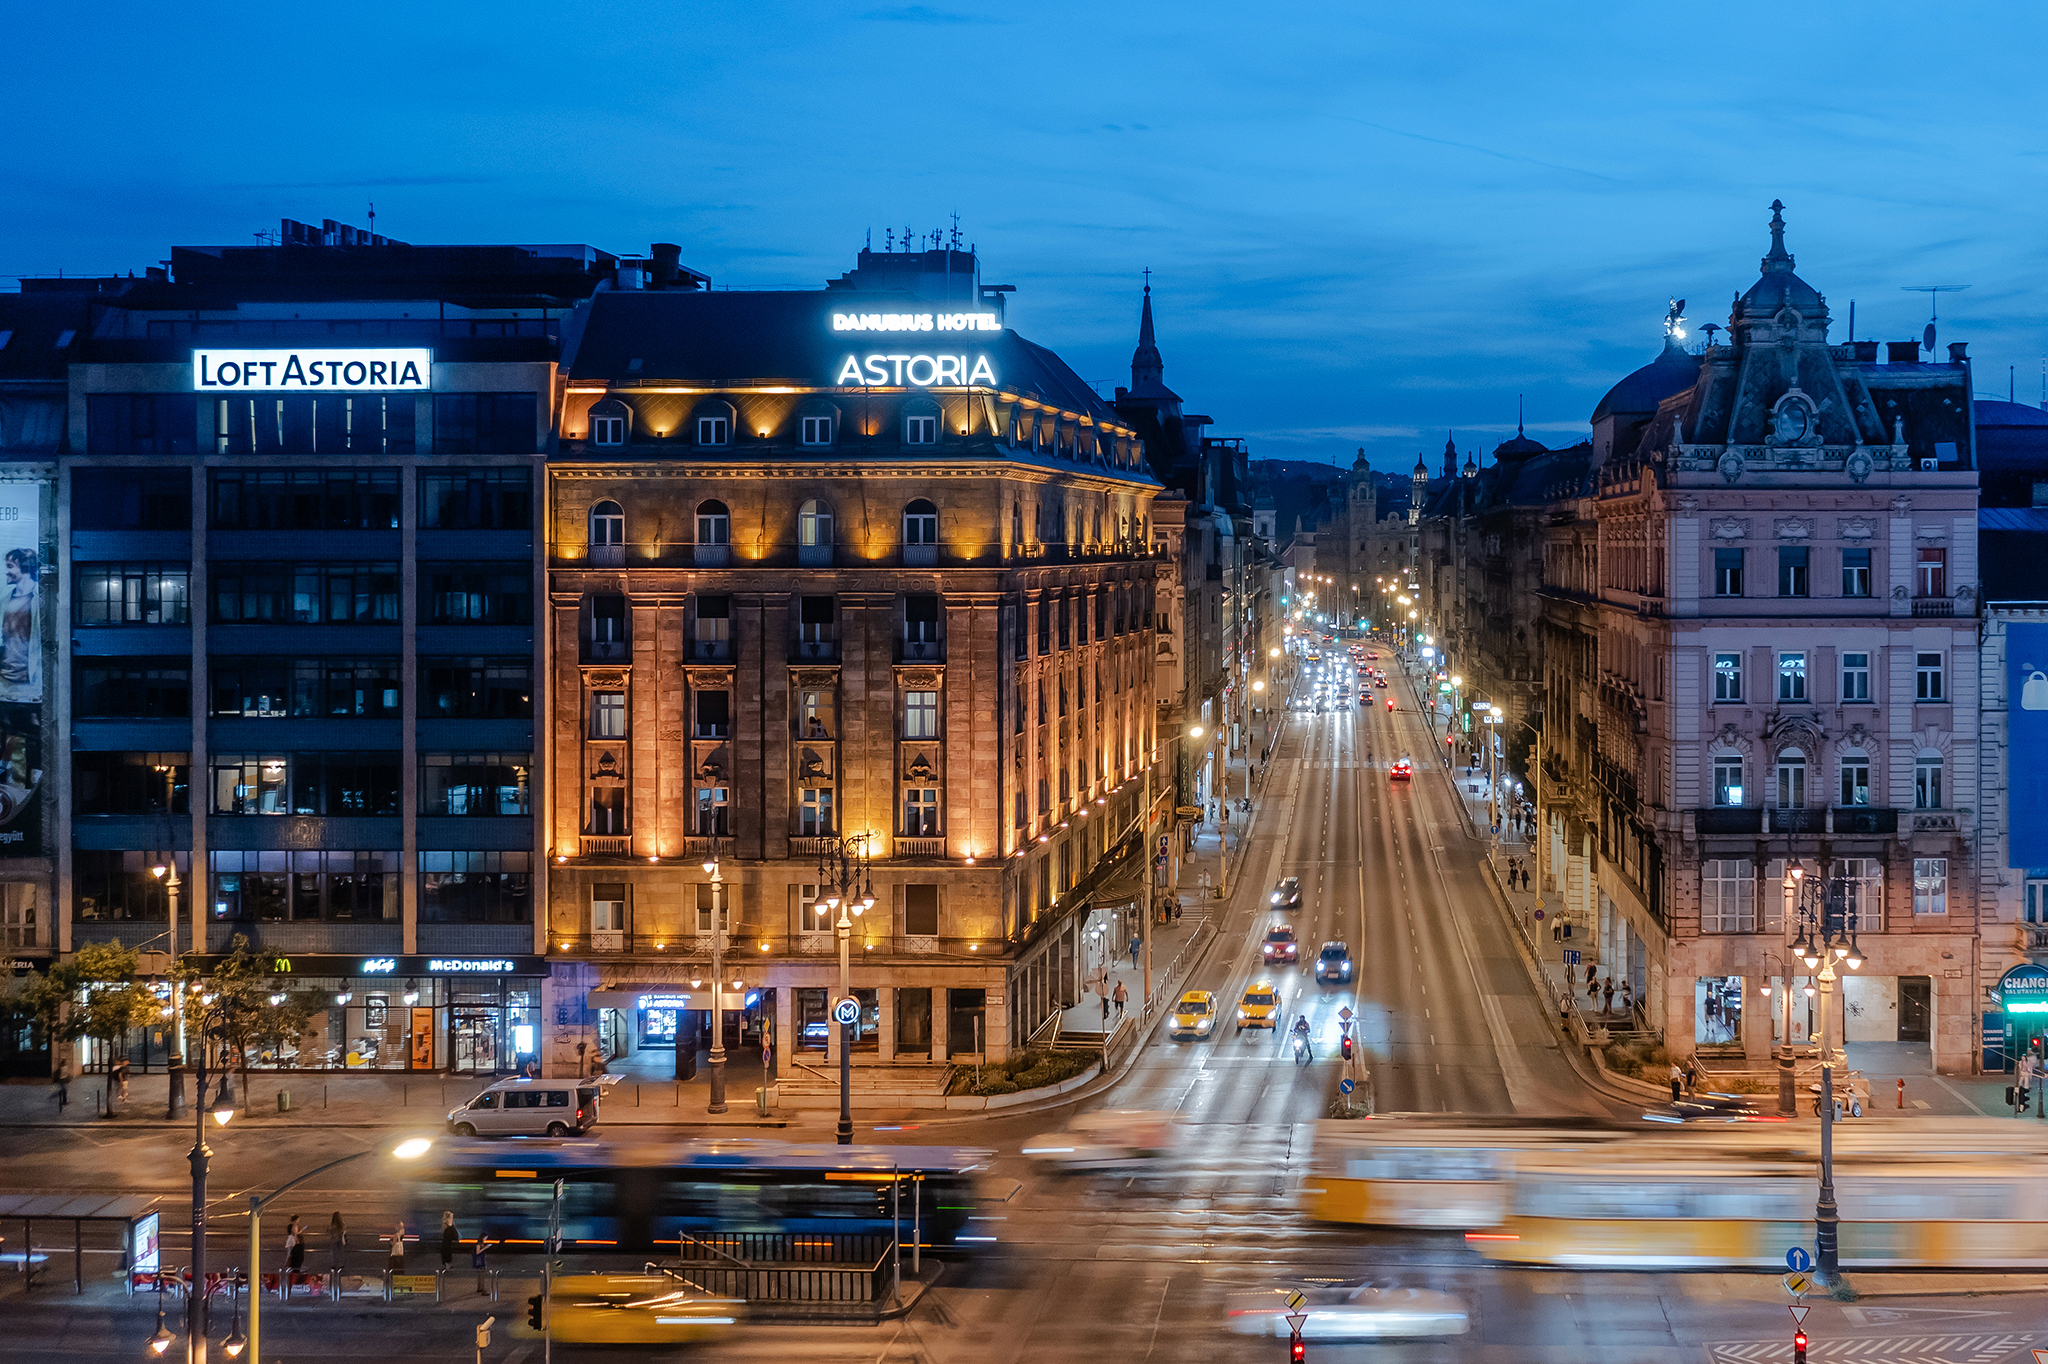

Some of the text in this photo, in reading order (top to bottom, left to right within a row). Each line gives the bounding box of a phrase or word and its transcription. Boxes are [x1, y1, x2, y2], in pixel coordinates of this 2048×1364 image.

[833, 313, 1001, 332] DANUBIUS HOTEL
[201, 354, 422, 387] LOFT ASTORIA
[837, 354, 997, 386] ASTORIA
[429, 959, 515, 971] McDonald's
